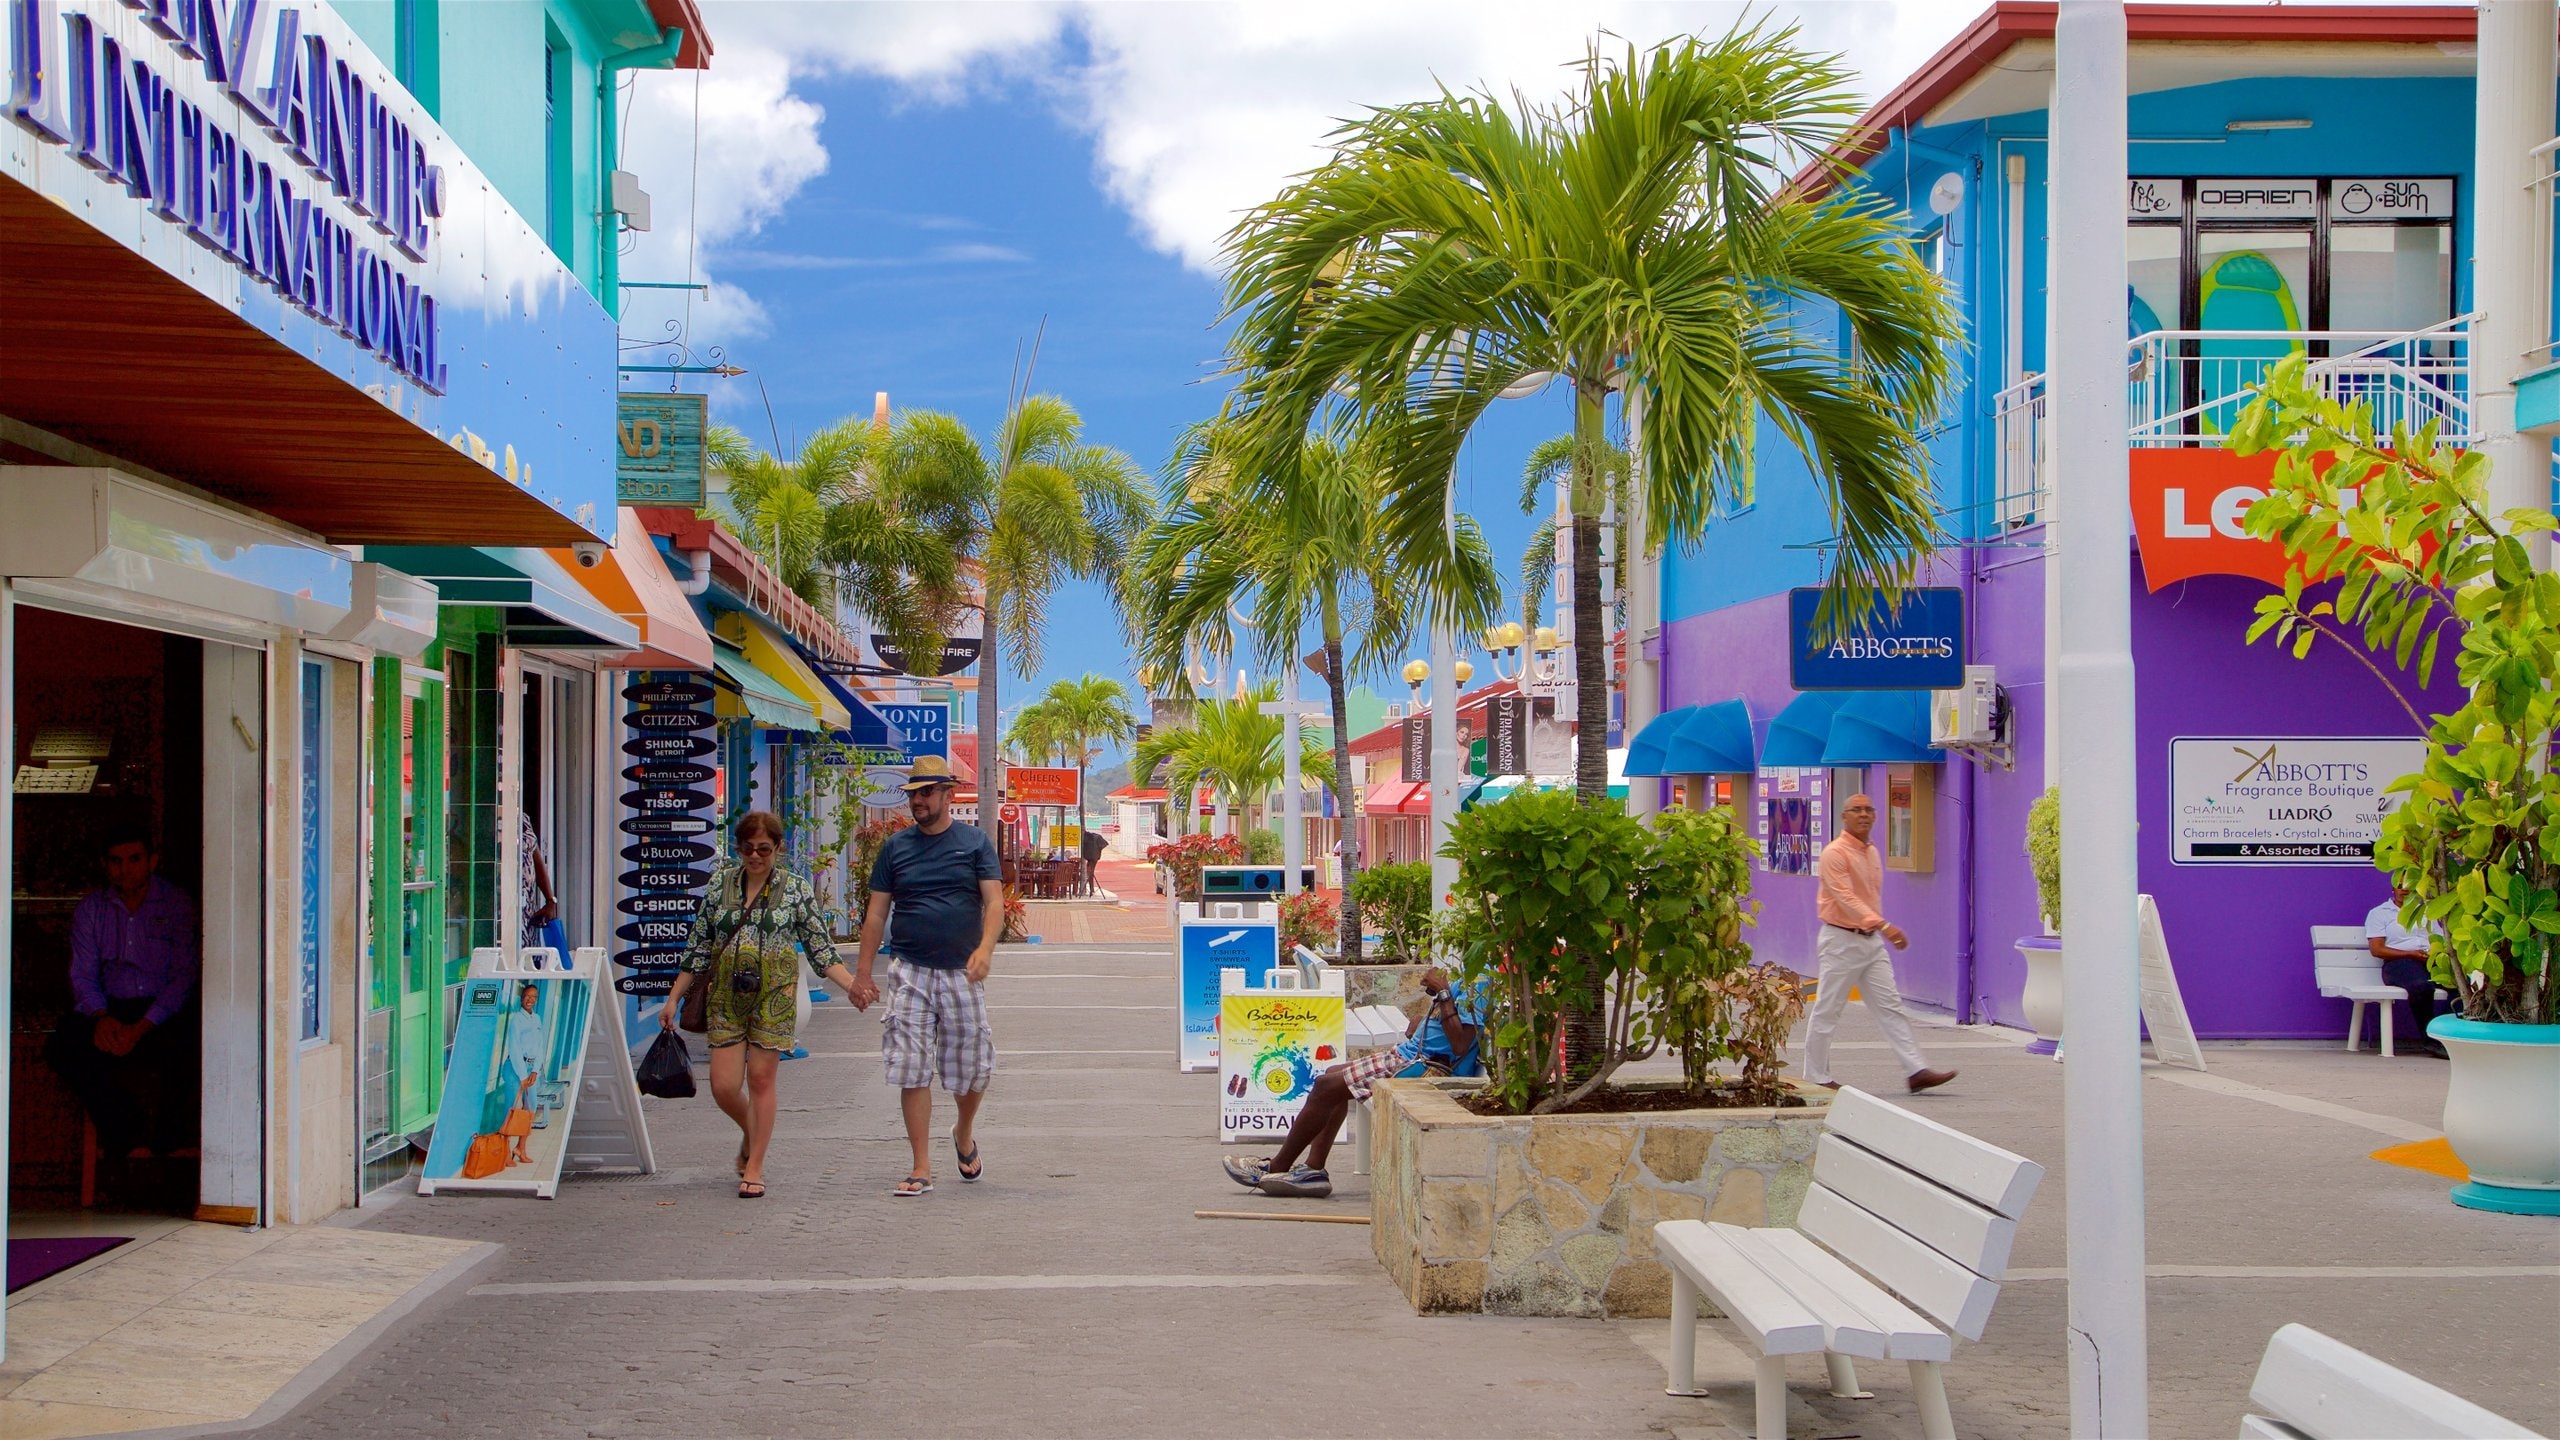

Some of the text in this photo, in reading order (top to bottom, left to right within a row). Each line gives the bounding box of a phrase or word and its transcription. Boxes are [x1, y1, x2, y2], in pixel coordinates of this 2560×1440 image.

[115, 0, 428, 263] NZANITE
[2131, 181, 2170, 213] Life
[2201, 190, 2312, 204] OBRIEN
[65, 13, 447, 397] INTERNATIONAL
[947, 647, 973, 657] FIRE
[1828, 637, 1953, 659] ABBOTT'S
[642, 694, 669, 702] PHILIP
[641, 715, 698, 726] CITIZEN
[645, 739, 695, 750] SHINOLA
[1020, 770, 1061, 782] CHEERS
[2256, 762, 2368, 782] ABBOTT'S
[2225, 783, 2374, 799] Fragrance Boutique
[644, 799, 690, 808] TISSOT
[2183, 805, 2245, 814] CHAMILIA
[2269, 805, 2332, 822] LLADRÓ
[2183, 828, 2219, 838] Charm
[2223, 828, 2272, 838] Bracelets
[2282, 828, 2320, 841] Crystal
[2331, 828, 2362, 838] China
[651, 848, 694, 858] BULOVA
[2240, 845, 2361, 856] & Assorted Gifts
[641, 875, 690, 885] FOSSIL
[634, 900, 695, 911] G-SHOCK
[638, 923, 687, 937] VERSUS
[632, 953, 682, 965] swatch
[636, 981, 672, 989] MICHAEL
[1247, 1009, 1317, 1022] Baobab
[1185, 1024, 1214, 1033] Island
